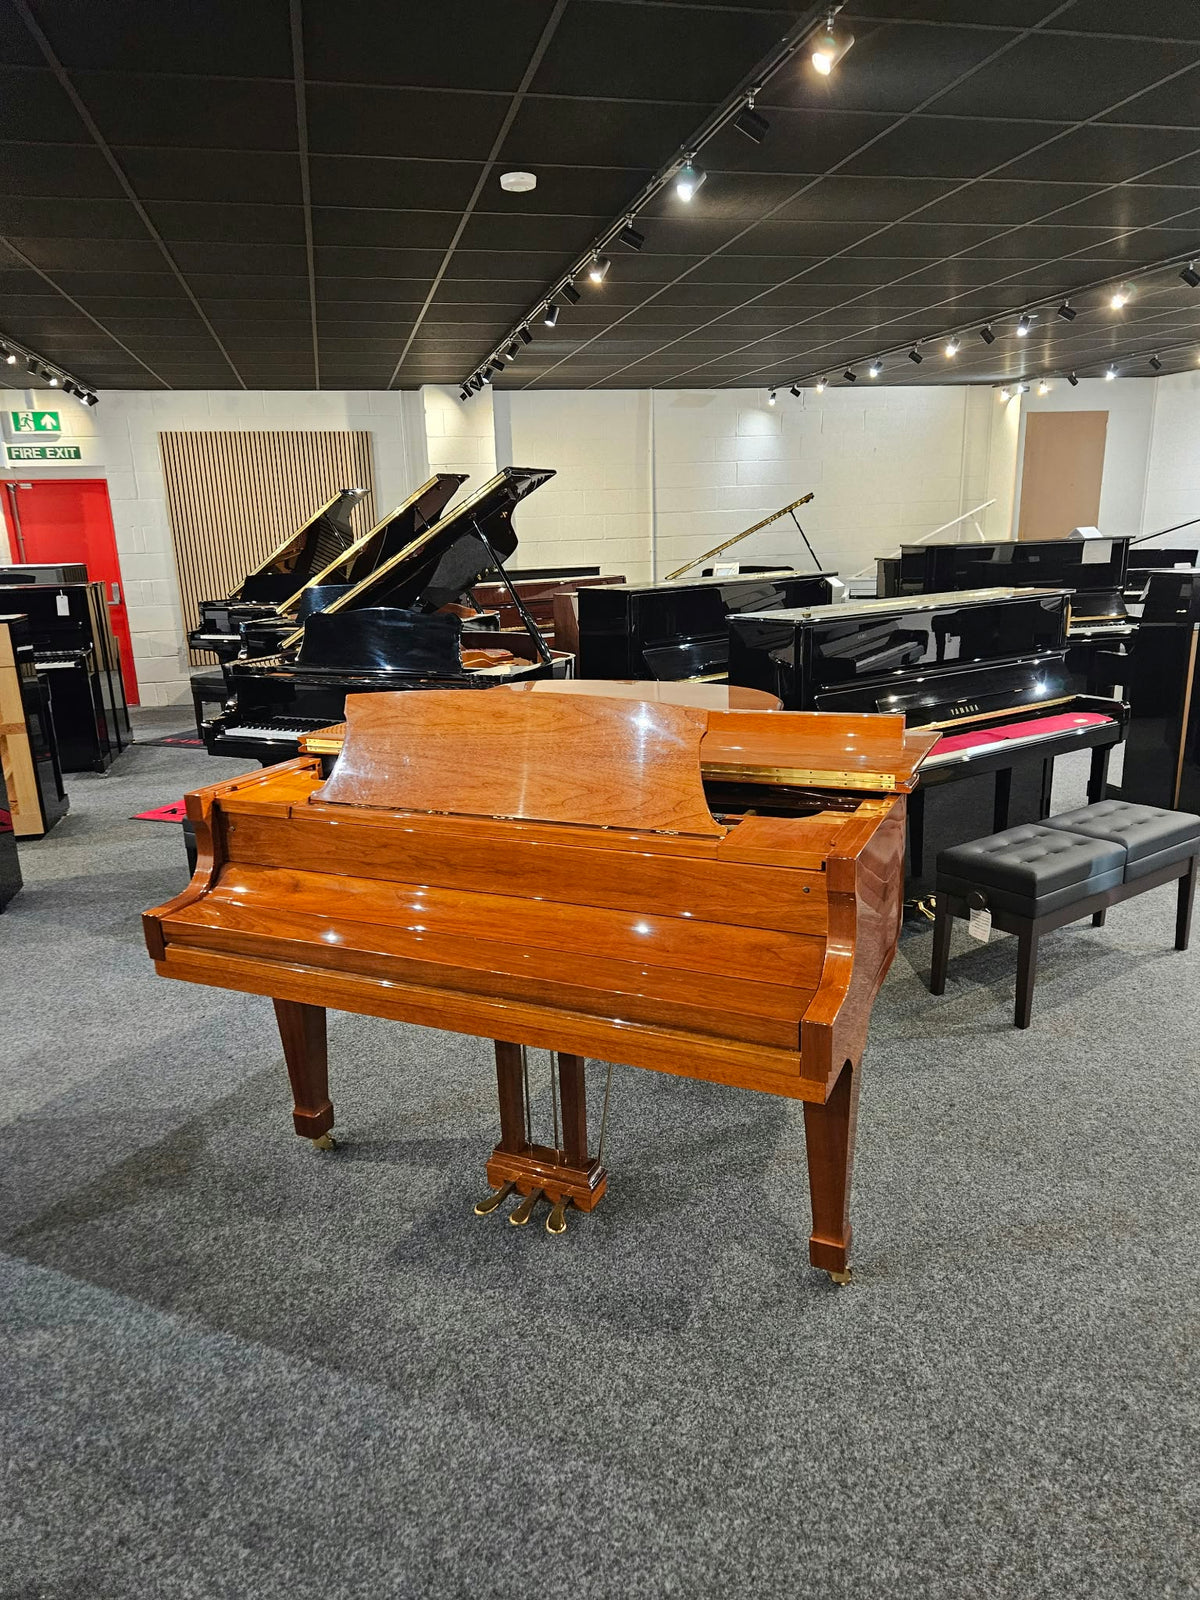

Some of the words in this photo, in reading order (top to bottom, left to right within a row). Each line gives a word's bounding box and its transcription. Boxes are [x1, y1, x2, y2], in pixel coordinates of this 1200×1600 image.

[10, 447, 42, 459] FIRE
[45, 447, 77, 459] EXIT
[950, 704, 979, 716] YAMAHA
